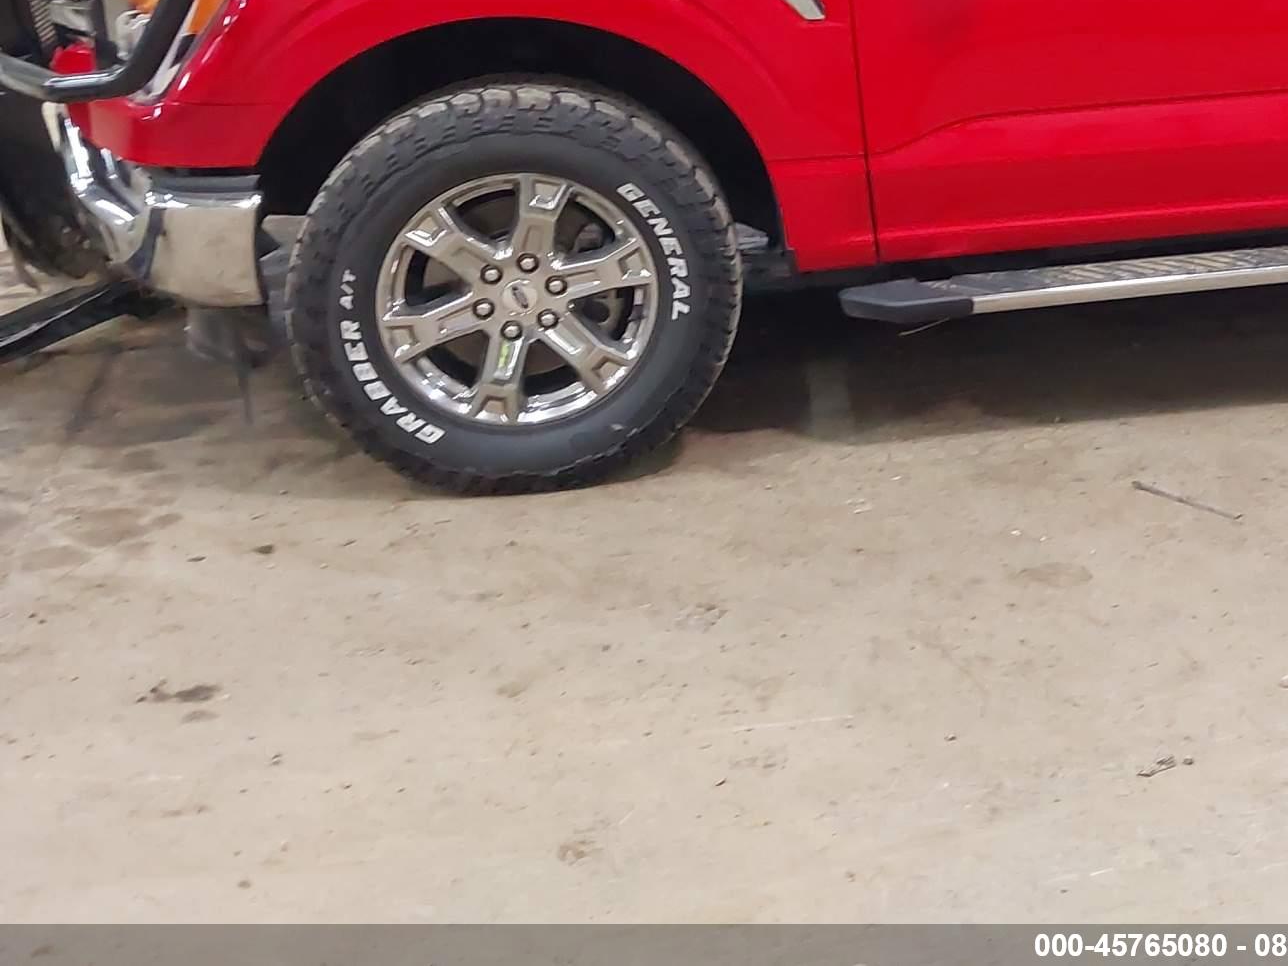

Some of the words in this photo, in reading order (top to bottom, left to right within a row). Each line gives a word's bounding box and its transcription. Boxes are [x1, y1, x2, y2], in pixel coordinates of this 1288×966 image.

[338, 268, 358, 311] A/T
[615, 182, 691, 321] GENERAL
[339, 319, 447, 445] GRABBER
